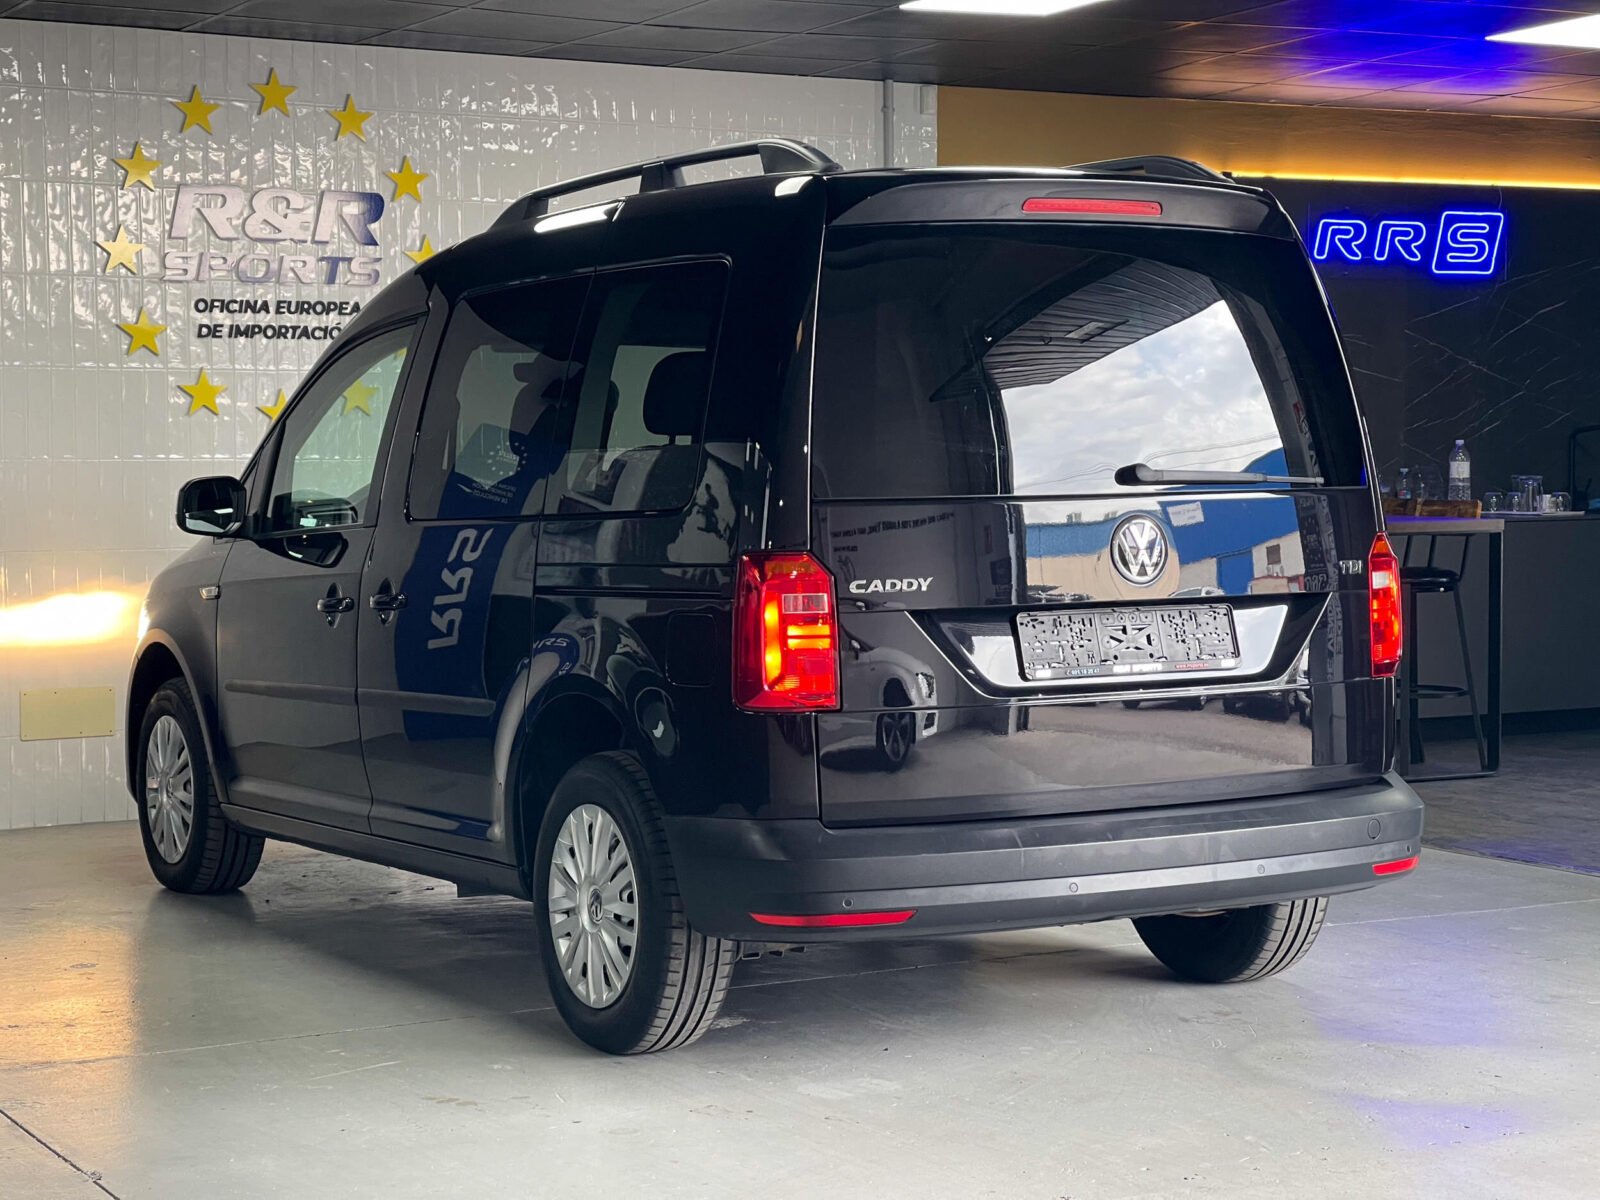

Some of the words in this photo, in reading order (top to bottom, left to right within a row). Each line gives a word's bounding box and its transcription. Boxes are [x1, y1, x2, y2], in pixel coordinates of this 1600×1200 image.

[168, 184, 385, 246] R&R
[1314, 218, 1490, 263] RRS
[163, 251, 383, 287] SPORTS
[194, 298, 270, 314] OFICINA
[275, 300, 361, 315] EUROPEA
[197, 323, 224, 339] DE
[228, 322, 343, 340] IMPORTACIÓ
[1339, 559, 1362, 574] TDI
[849, 577, 934, 594] CADDY
